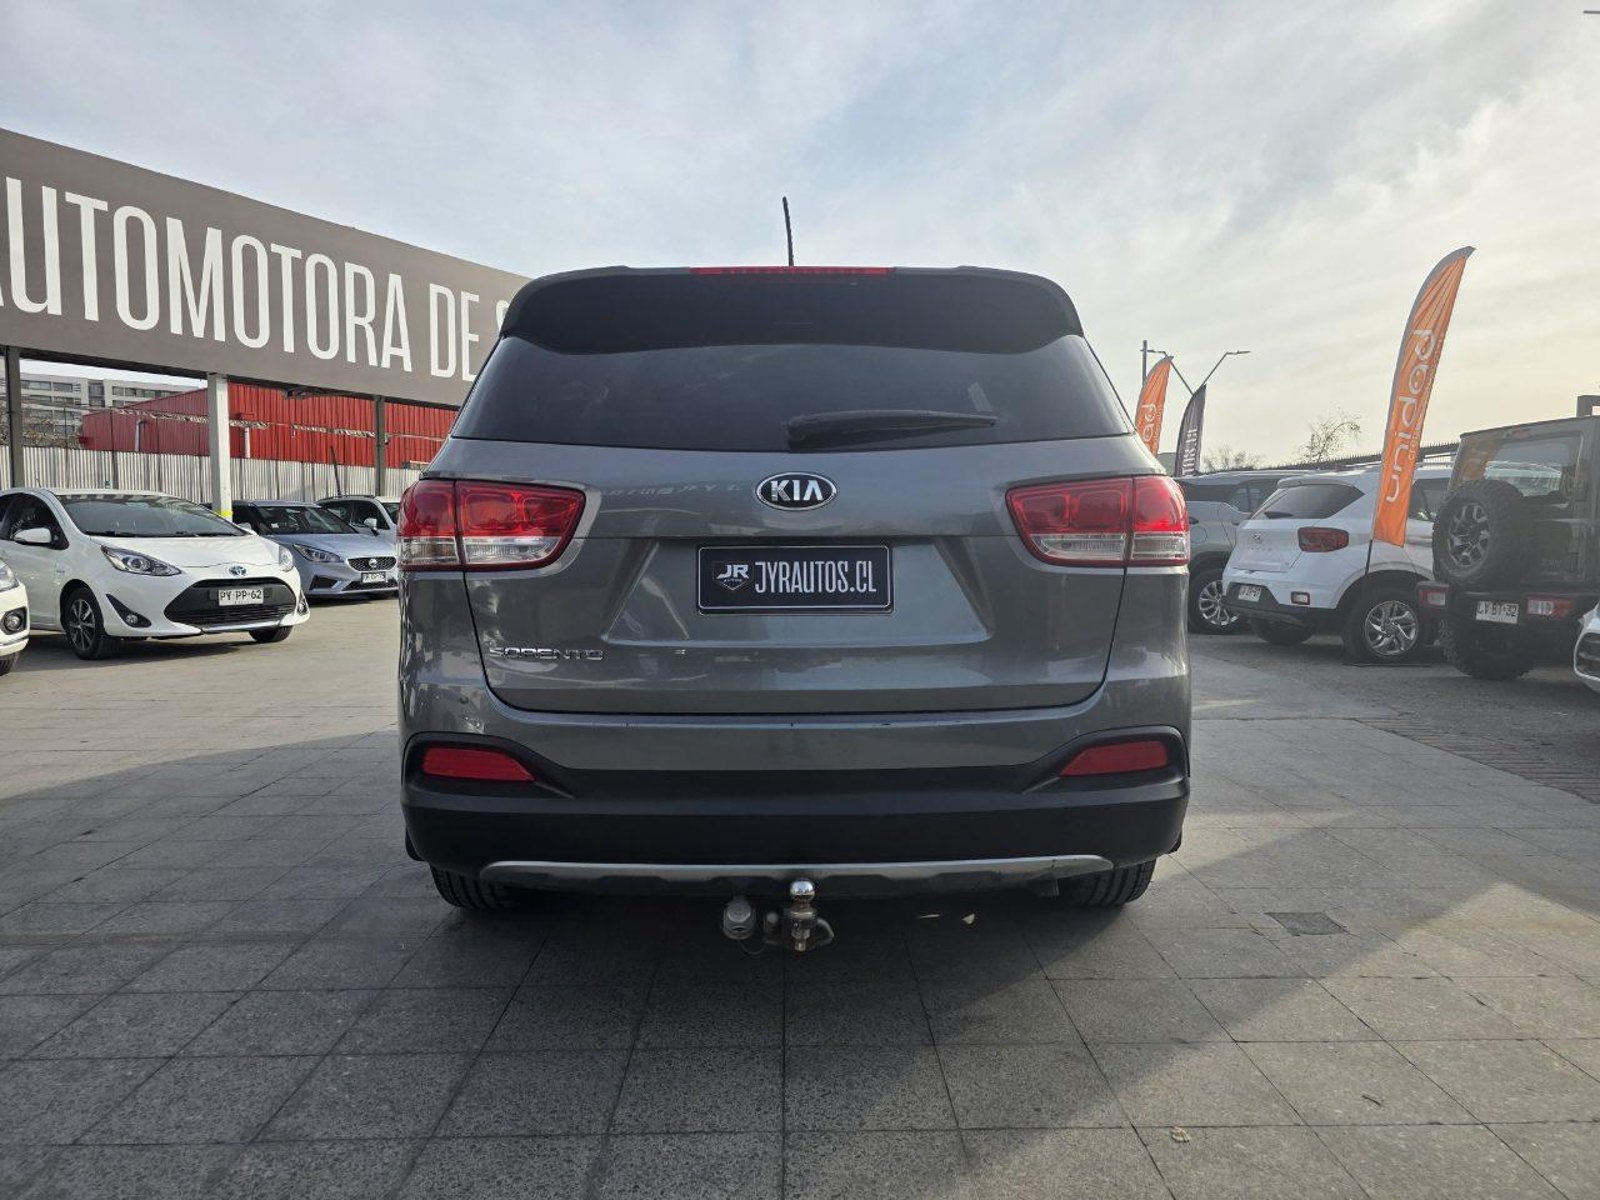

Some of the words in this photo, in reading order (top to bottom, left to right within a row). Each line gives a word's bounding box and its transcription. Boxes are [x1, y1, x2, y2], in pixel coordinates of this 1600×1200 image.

[0, 176, 412, 373] UTOMOTORA
[429, 283, 480, 382] DE
[1141, 402, 1157, 442] ad
[1386, 329, 1436, 502] unidad
[770, 479, 825, 501] KIA
[716, 564, 750, 580] JR
[754, 560, 877, 593] JYRAUTOS.CL
